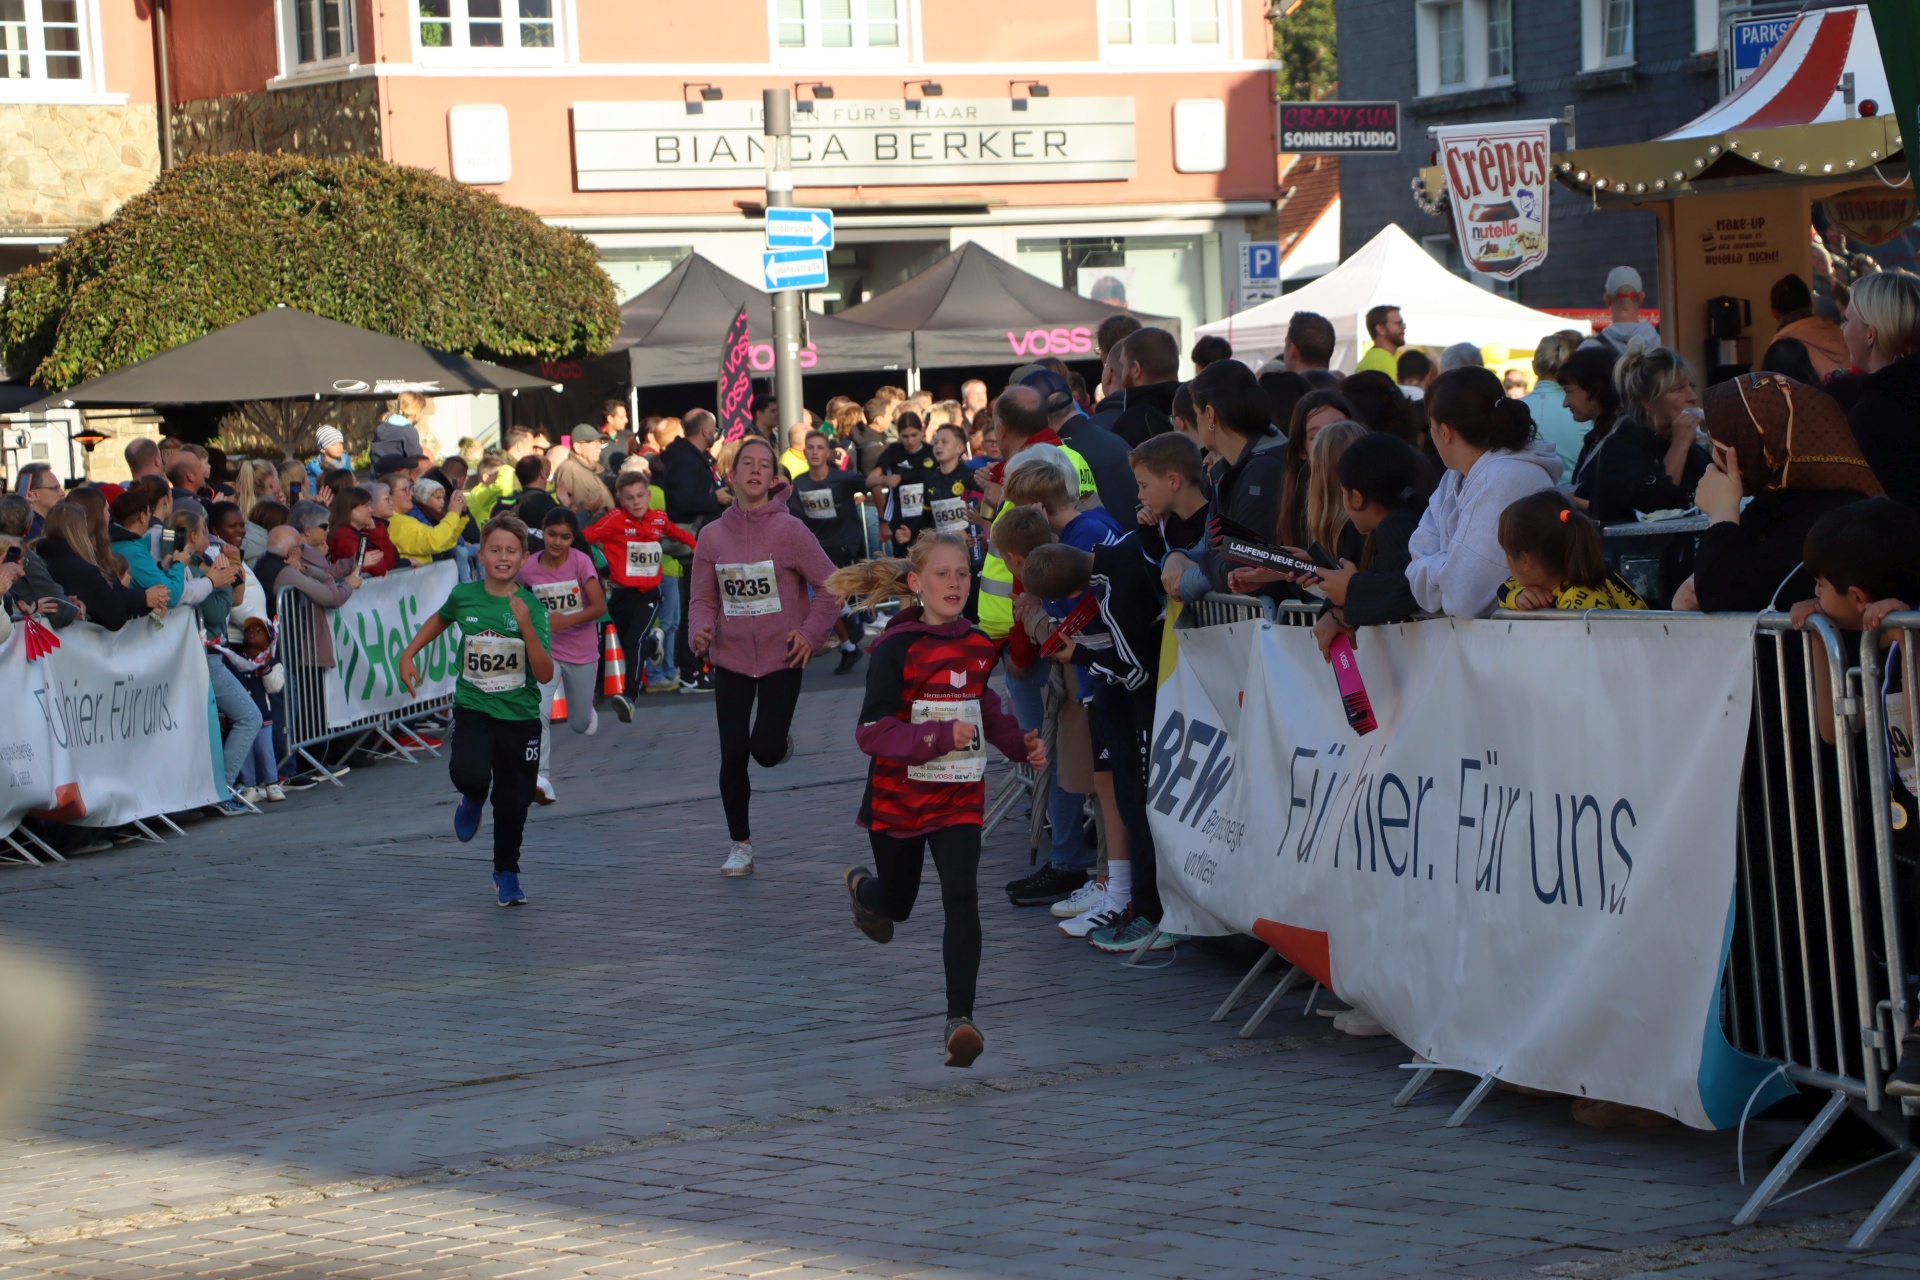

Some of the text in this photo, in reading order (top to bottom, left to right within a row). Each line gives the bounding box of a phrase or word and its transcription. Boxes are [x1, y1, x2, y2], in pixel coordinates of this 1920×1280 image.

[1742, 21, 1793, 45] PARKS
[833, 103, 901, 121] FÜR'S
[915, 105, 978, 120] HAAR
[1284, 107, 1396, 128] CRAZY SUN
[875, 131, 1068, 161] BERKER
[1284, 131, 1396, 148] SONNENSTUDIO
[1446, 137, 1546, 200] Crêpes
[1472, 220, 1518, 240] nutella
[1255, 248, 1272, 276] P
[1007, 327, 1092, 357] VOSS
[721, 371, 750, 420] VOSS
[935, 507, 963, 523] 5630
[631, 552, 660, 564] 5610
[1230, 542, 1269, 559] LAUFEND
[1270, 554, 1294, 567] NEUE
[724, 577, 771, 597] 6235
[467, 653, 519, 672] 5624
[1338, 650, 1350, 670] VOSS
[110, 674, 142, 742] Für
[143, 680, 178, 738] uns.
[525, 747, 539, 761] DS
[1146, 709, 1236, 829] BEW
[1455, 750, 1521, 894] Für
[1529, 791, 1637, 915] uns.
